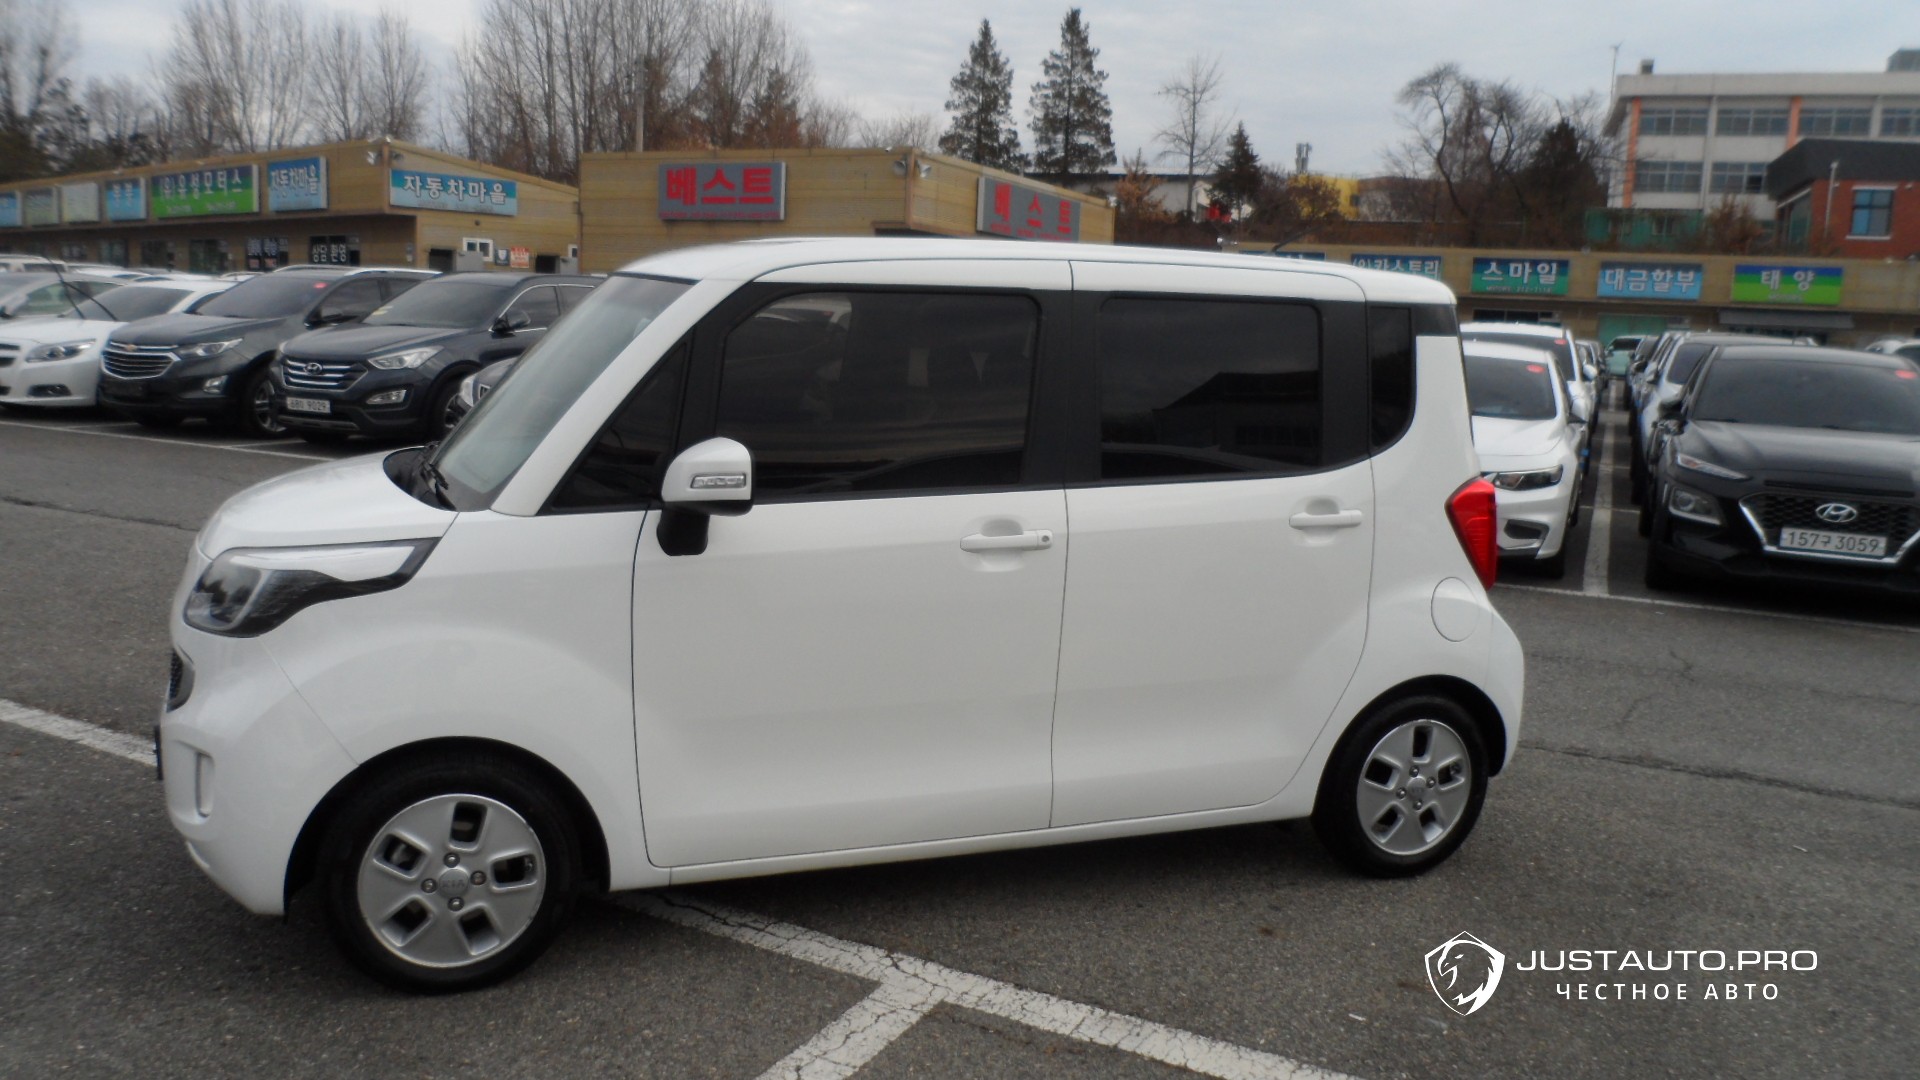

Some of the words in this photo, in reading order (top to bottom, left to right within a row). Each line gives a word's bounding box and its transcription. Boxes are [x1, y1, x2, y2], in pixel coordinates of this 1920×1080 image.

[270, 164, 319, 198] 자동차마을
[403, 174, 507, 205] 자동차마을
[666, 166, 775, 206] 베스트
[994, 182, 1073, 234] 베스트
[1481, 262, 1558, 285] 스마일
[1604, 268, 1696, 293] 대금할부
[1834, 534, 1880, 552] 3059
